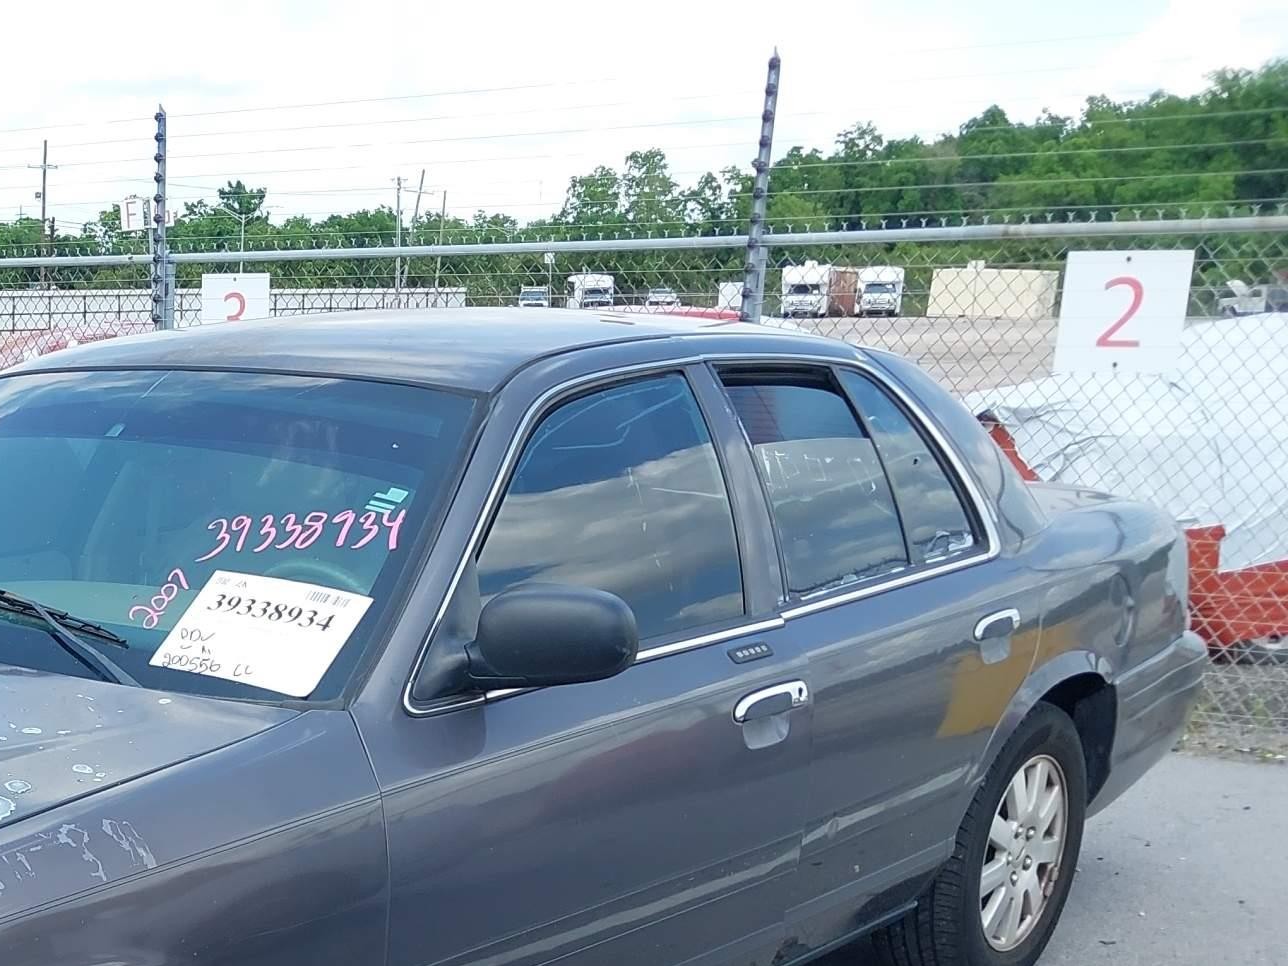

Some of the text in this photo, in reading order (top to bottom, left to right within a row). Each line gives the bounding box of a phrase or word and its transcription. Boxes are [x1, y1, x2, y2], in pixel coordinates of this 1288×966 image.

[1095, 276, 1145, 348] 2
[195, 508, 406, 562] 39338934
[128, 567, 191, 630] 2007
[206, 592, 336, 632] 39338934
